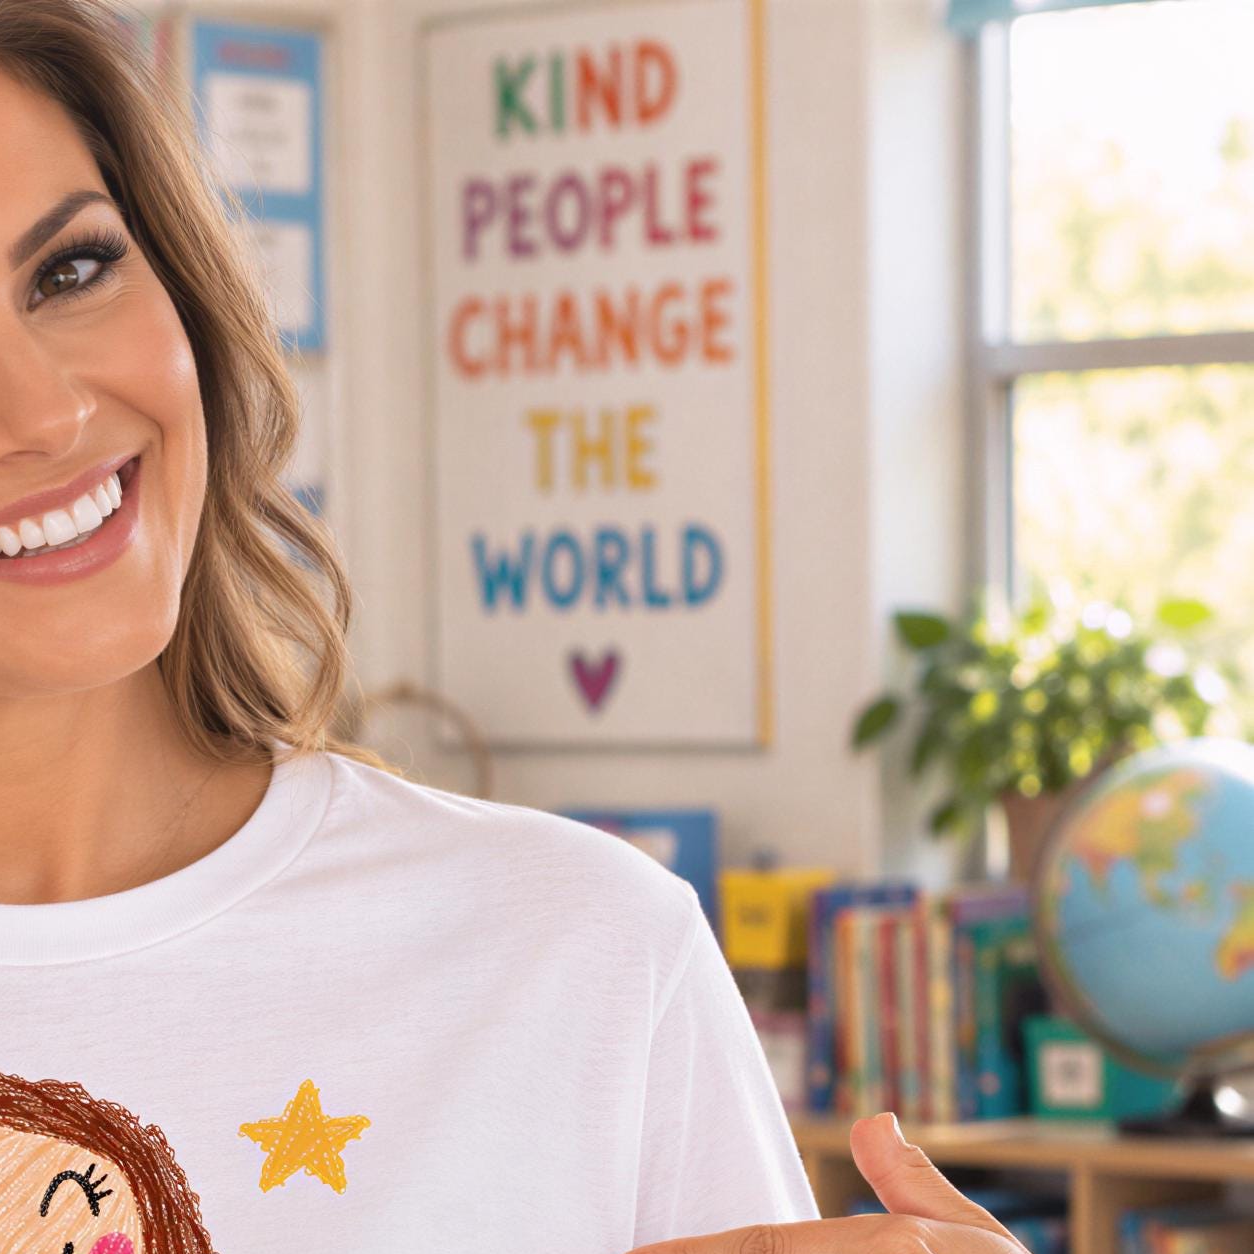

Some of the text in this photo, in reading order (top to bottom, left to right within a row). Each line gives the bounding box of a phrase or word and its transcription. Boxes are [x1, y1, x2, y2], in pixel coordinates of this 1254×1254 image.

[494, 40, 679, 138] KIND
[462, 160, 719, 260] PEOPLE
[448, 278, 735, 380] CHANGE
[524, 405, 658, 492] THE
[472, 524, 725, 613] WORLD
